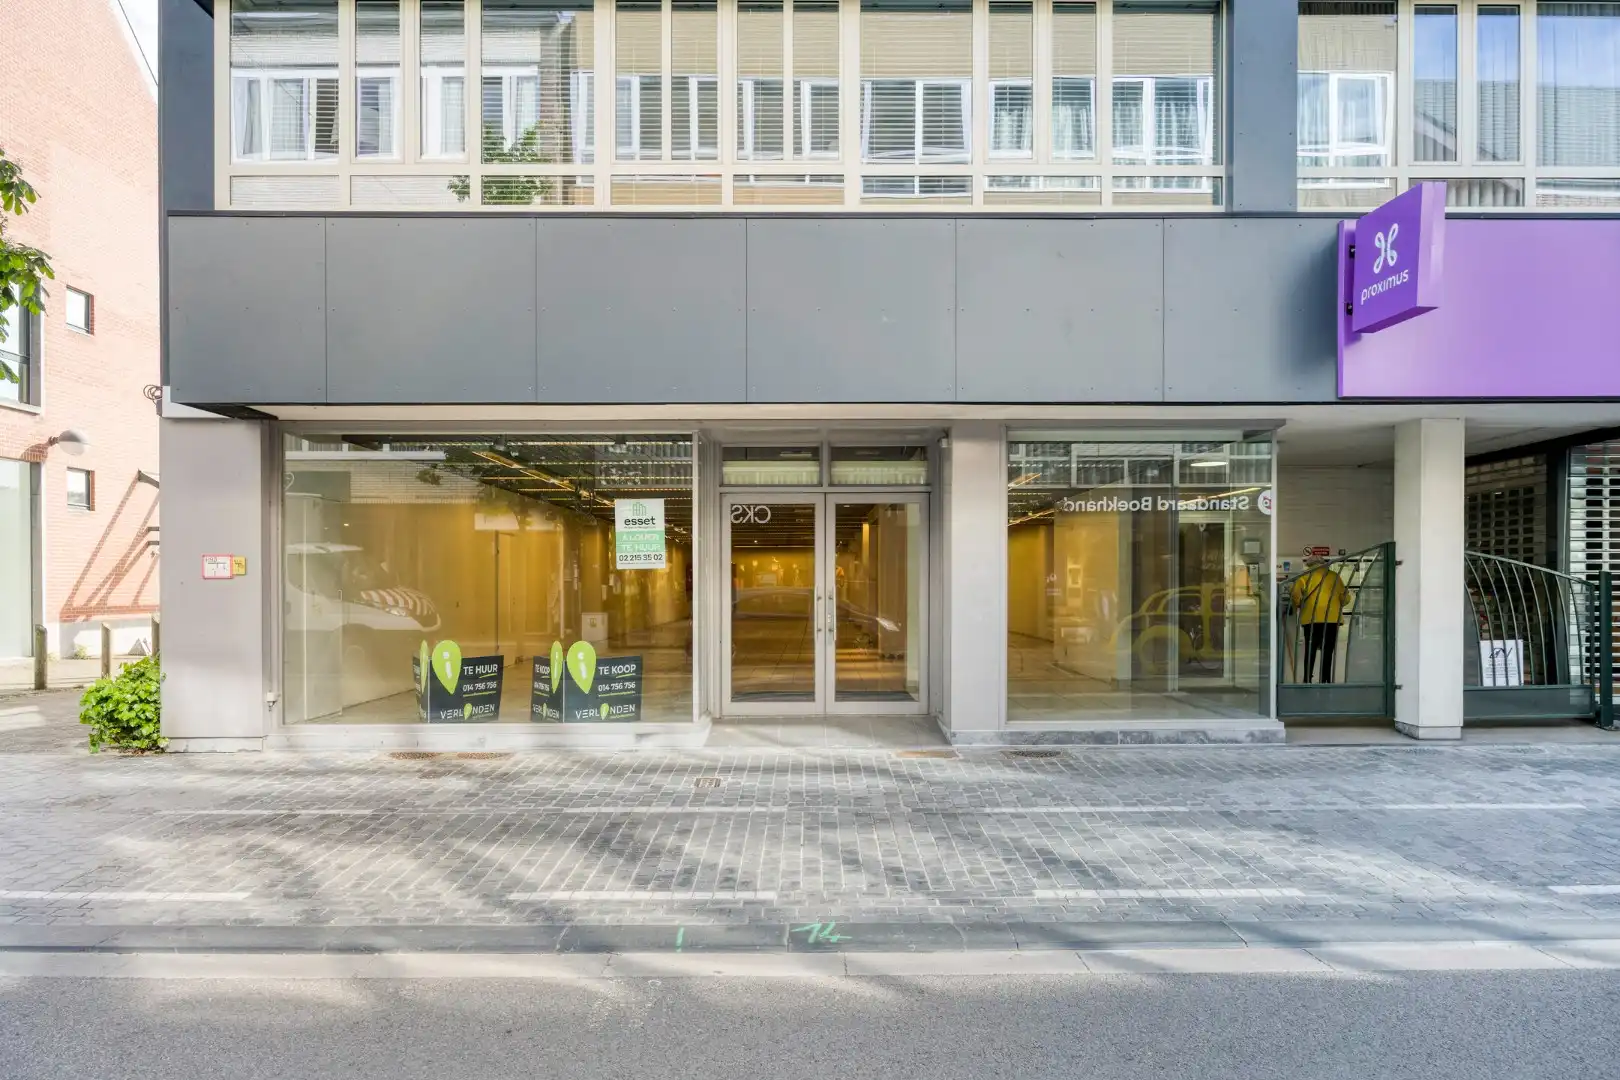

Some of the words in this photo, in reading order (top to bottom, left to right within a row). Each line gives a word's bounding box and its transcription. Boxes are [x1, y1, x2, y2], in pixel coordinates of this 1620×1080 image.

[1360, 269, 1409, 305] proximus
[624, 516, 656, 526] esset
[635, 543, 661, 552] HUUR
[619, 554, 629, 562] 02
[643, 553, 652, 561] 35
[653, 553, 663, 561] 02
[463, 665, 474, 676] TE
[475, 663, 498, 674] HUUR
[598, 666, 610, 676] TE
[611, 664, 637, 675] KOOP
[462, 683, 474, 692] 014
[474, 682, 486, 691] 756
[486, 681, 497, 690] 756
[598, 684, 610, 692] 014
[611, 683, 624, 691] 756
[624, 681, 636, 690] 756
